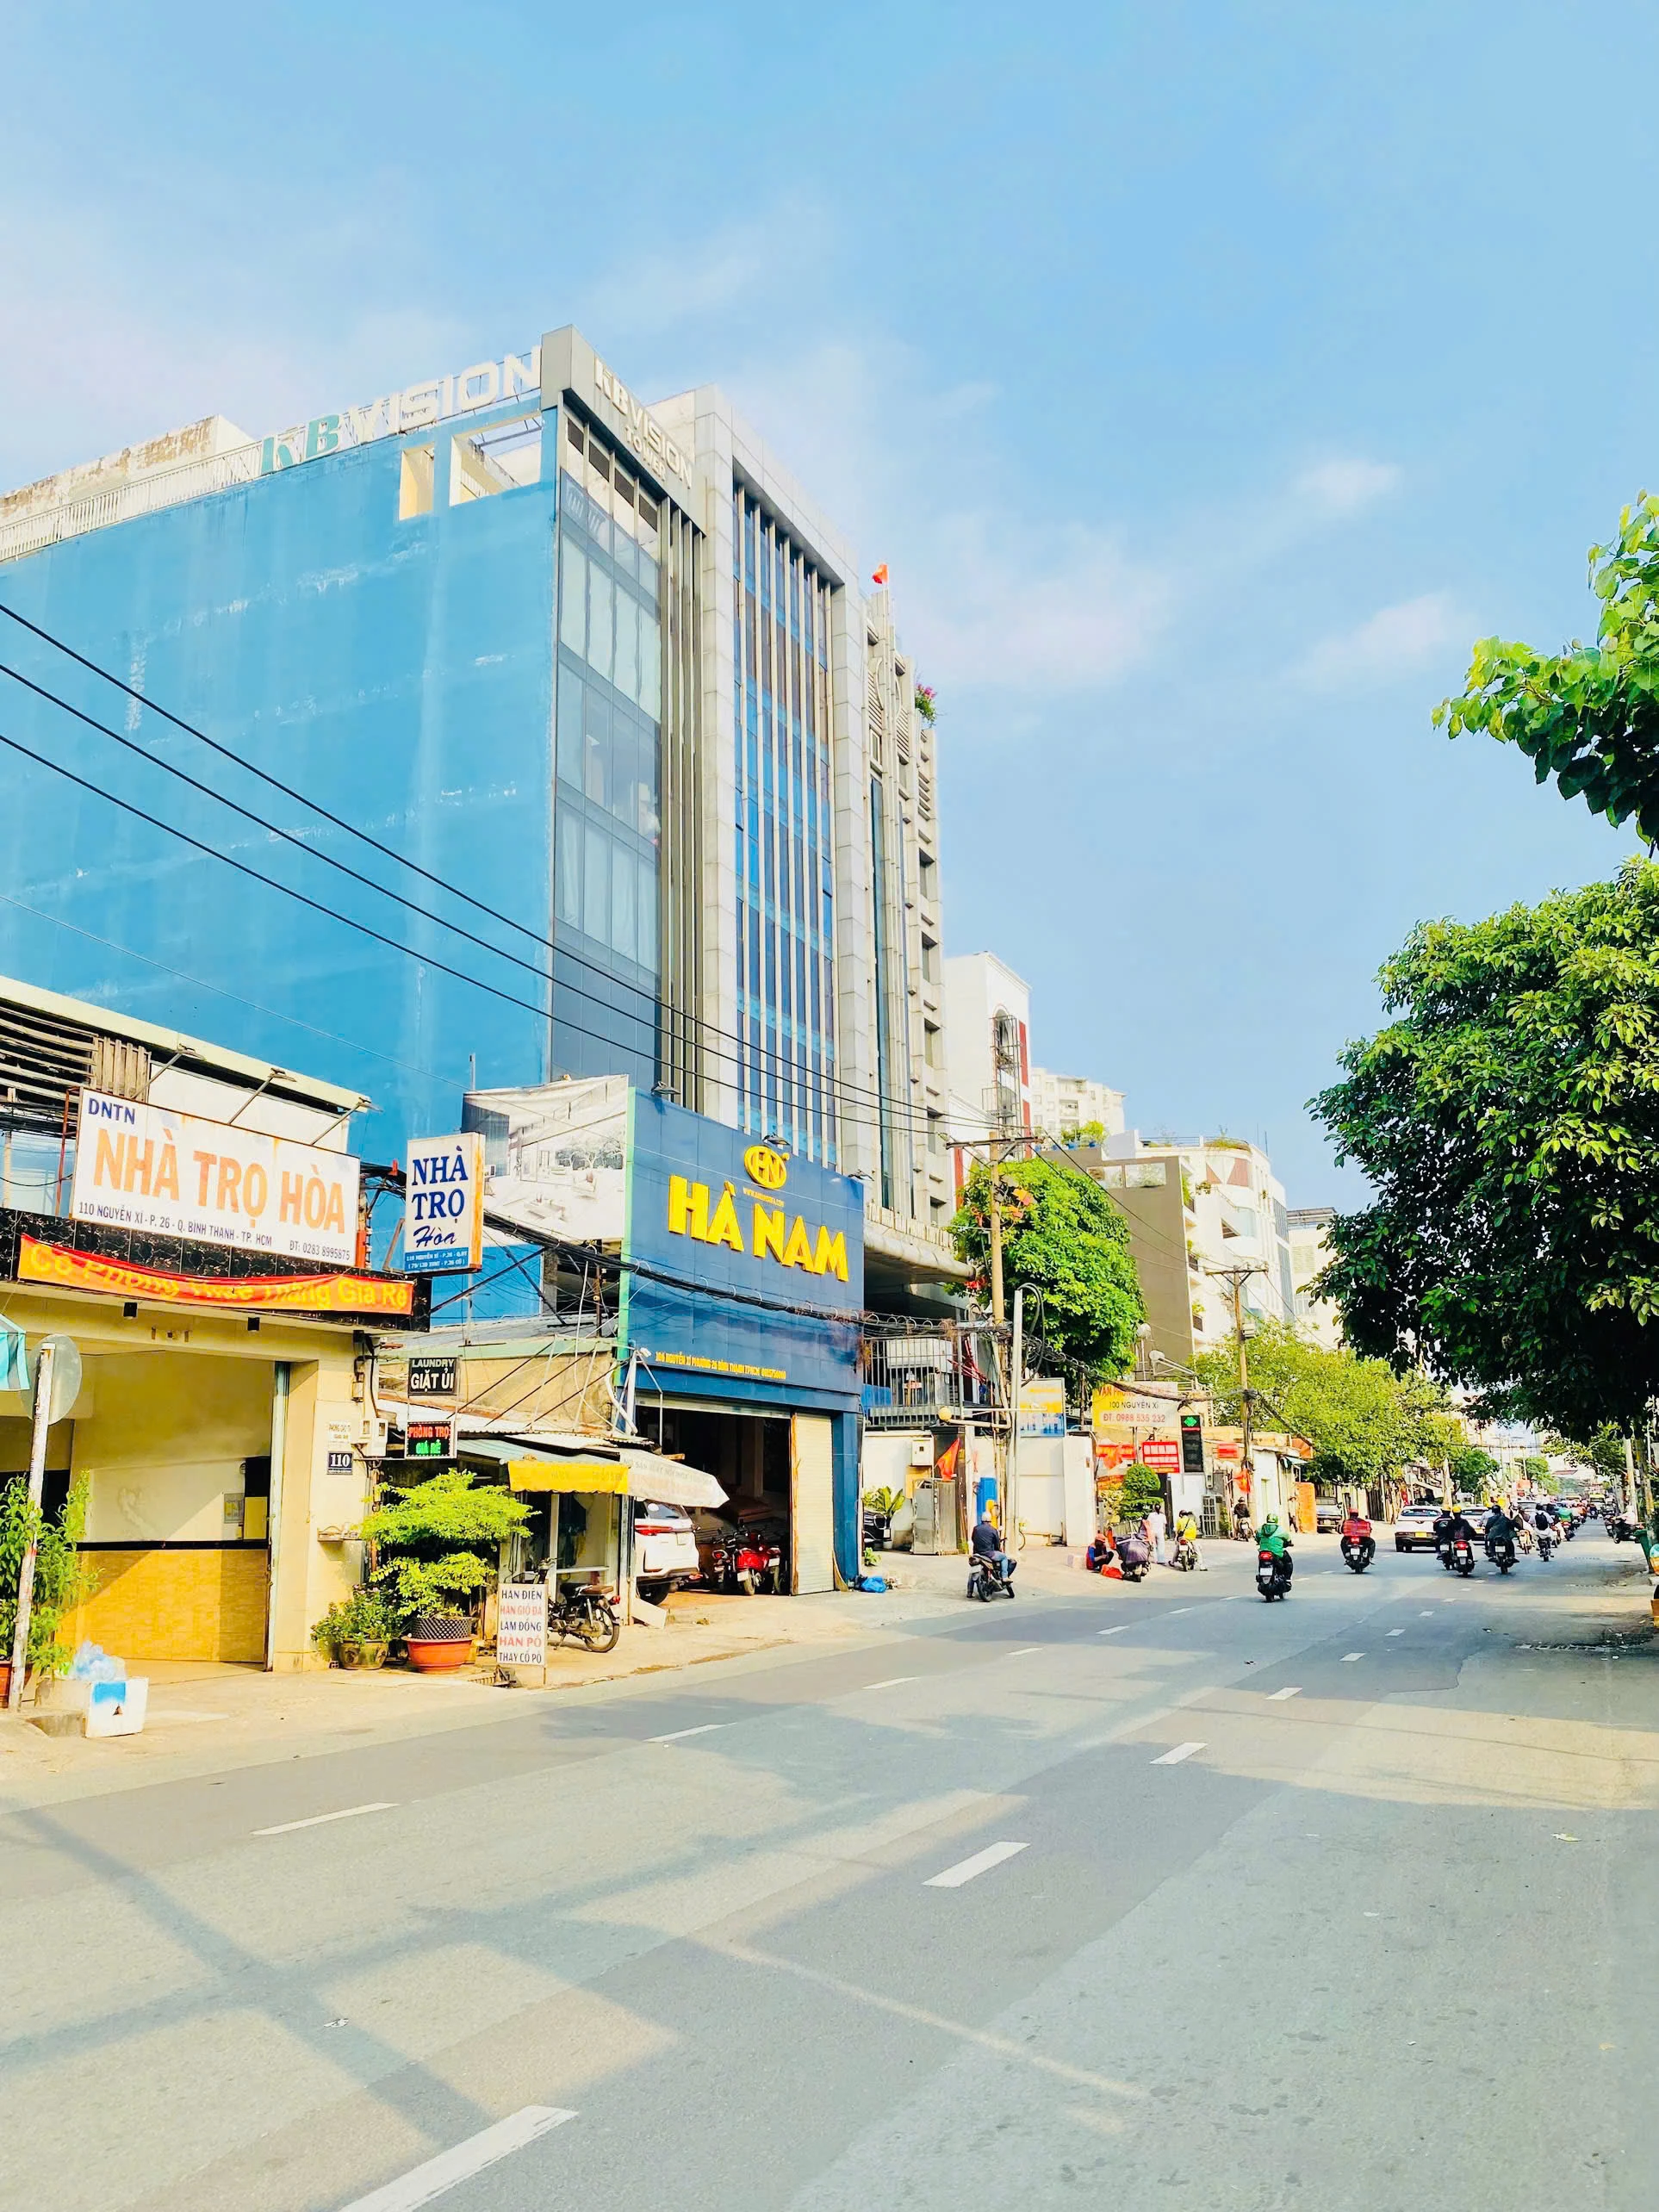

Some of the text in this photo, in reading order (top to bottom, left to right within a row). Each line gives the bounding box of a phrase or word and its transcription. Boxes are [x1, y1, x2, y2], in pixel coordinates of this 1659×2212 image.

[261, 345, 541, 475] KBVISION
[593, 357, 692, 489] KBVISION
[625, 426, 666, 482] TOWER
[88, 1097, 136, 1125] DNTN
[93, 1127, 345, 1233] NHÀ TRỌ HÒA
[412, 1146, 469, 1185] NHÀ
[78, 1202, 95, 1214] 110
[159, 1216, 171, 1228] 26
[177, 1219, 185, 1233] Q.
[256, 1233, 273, 1246] HCM
[411, 1189, 465, 1224] TRỌ
[413, 1225, 457, 1248] Hòa
[668, 1174, 849, 1283] HÀ NAM
[302, 1242, 320, 1256] 0283
[410, 1367, 454, 1392] GIẶT ỦI
[412, 1359, 455, 1368] LAUNDRY
[330, 1454, 351, 1467] 110
